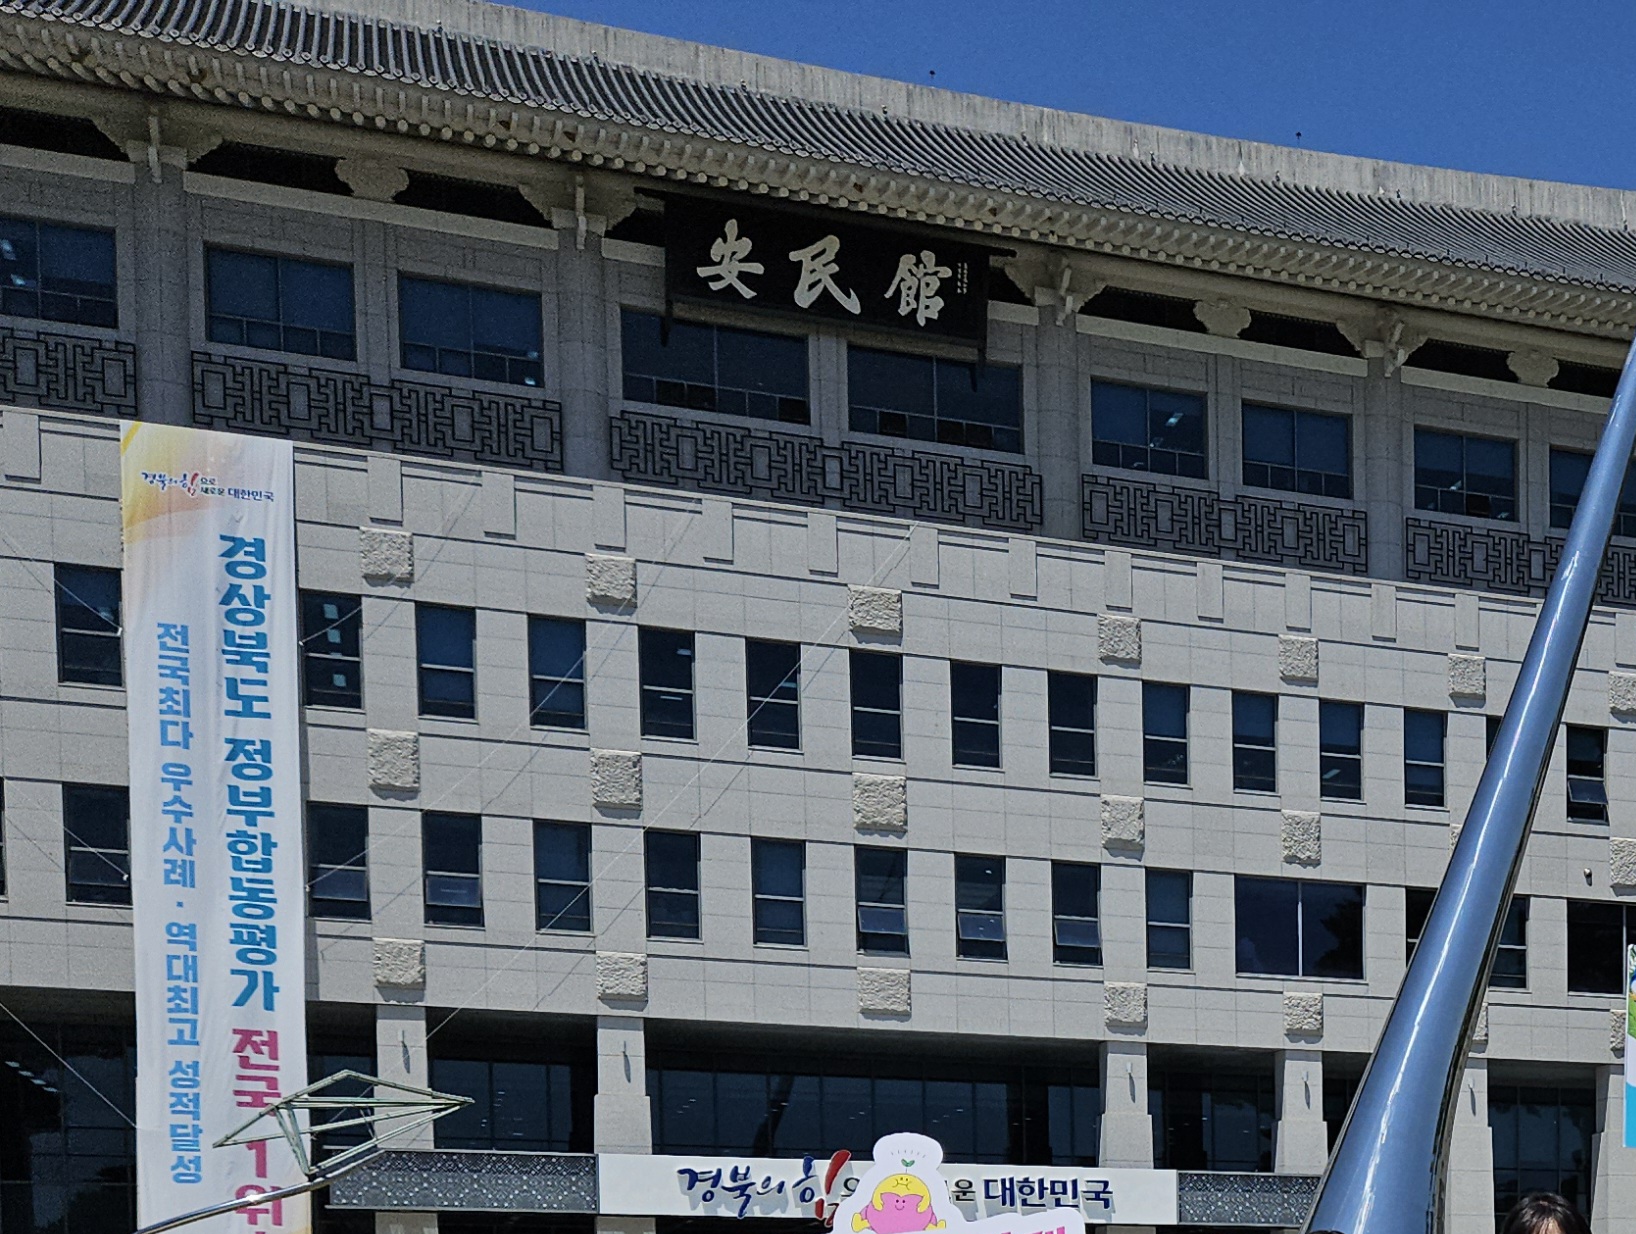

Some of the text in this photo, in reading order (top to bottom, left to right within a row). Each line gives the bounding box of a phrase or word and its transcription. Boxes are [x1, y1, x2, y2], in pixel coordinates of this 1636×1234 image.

[697, 218, 952, 327] 安民館
[141, 472, 178, 491] 경북의
[227, 488, 274, 502] 대한민국
[218, 534, 271, 719] 경상북도
[156, 622, 203, 1184] 전국최다 우수사례 역대최고 성적달성
[223, 738, 281, 1012] 정부합동평가
[232, 1028, 282, 1117] 전국
[677, 1166, 786, 1219] 경북의
[983, 1177, 1113, 1209] 대한민국
